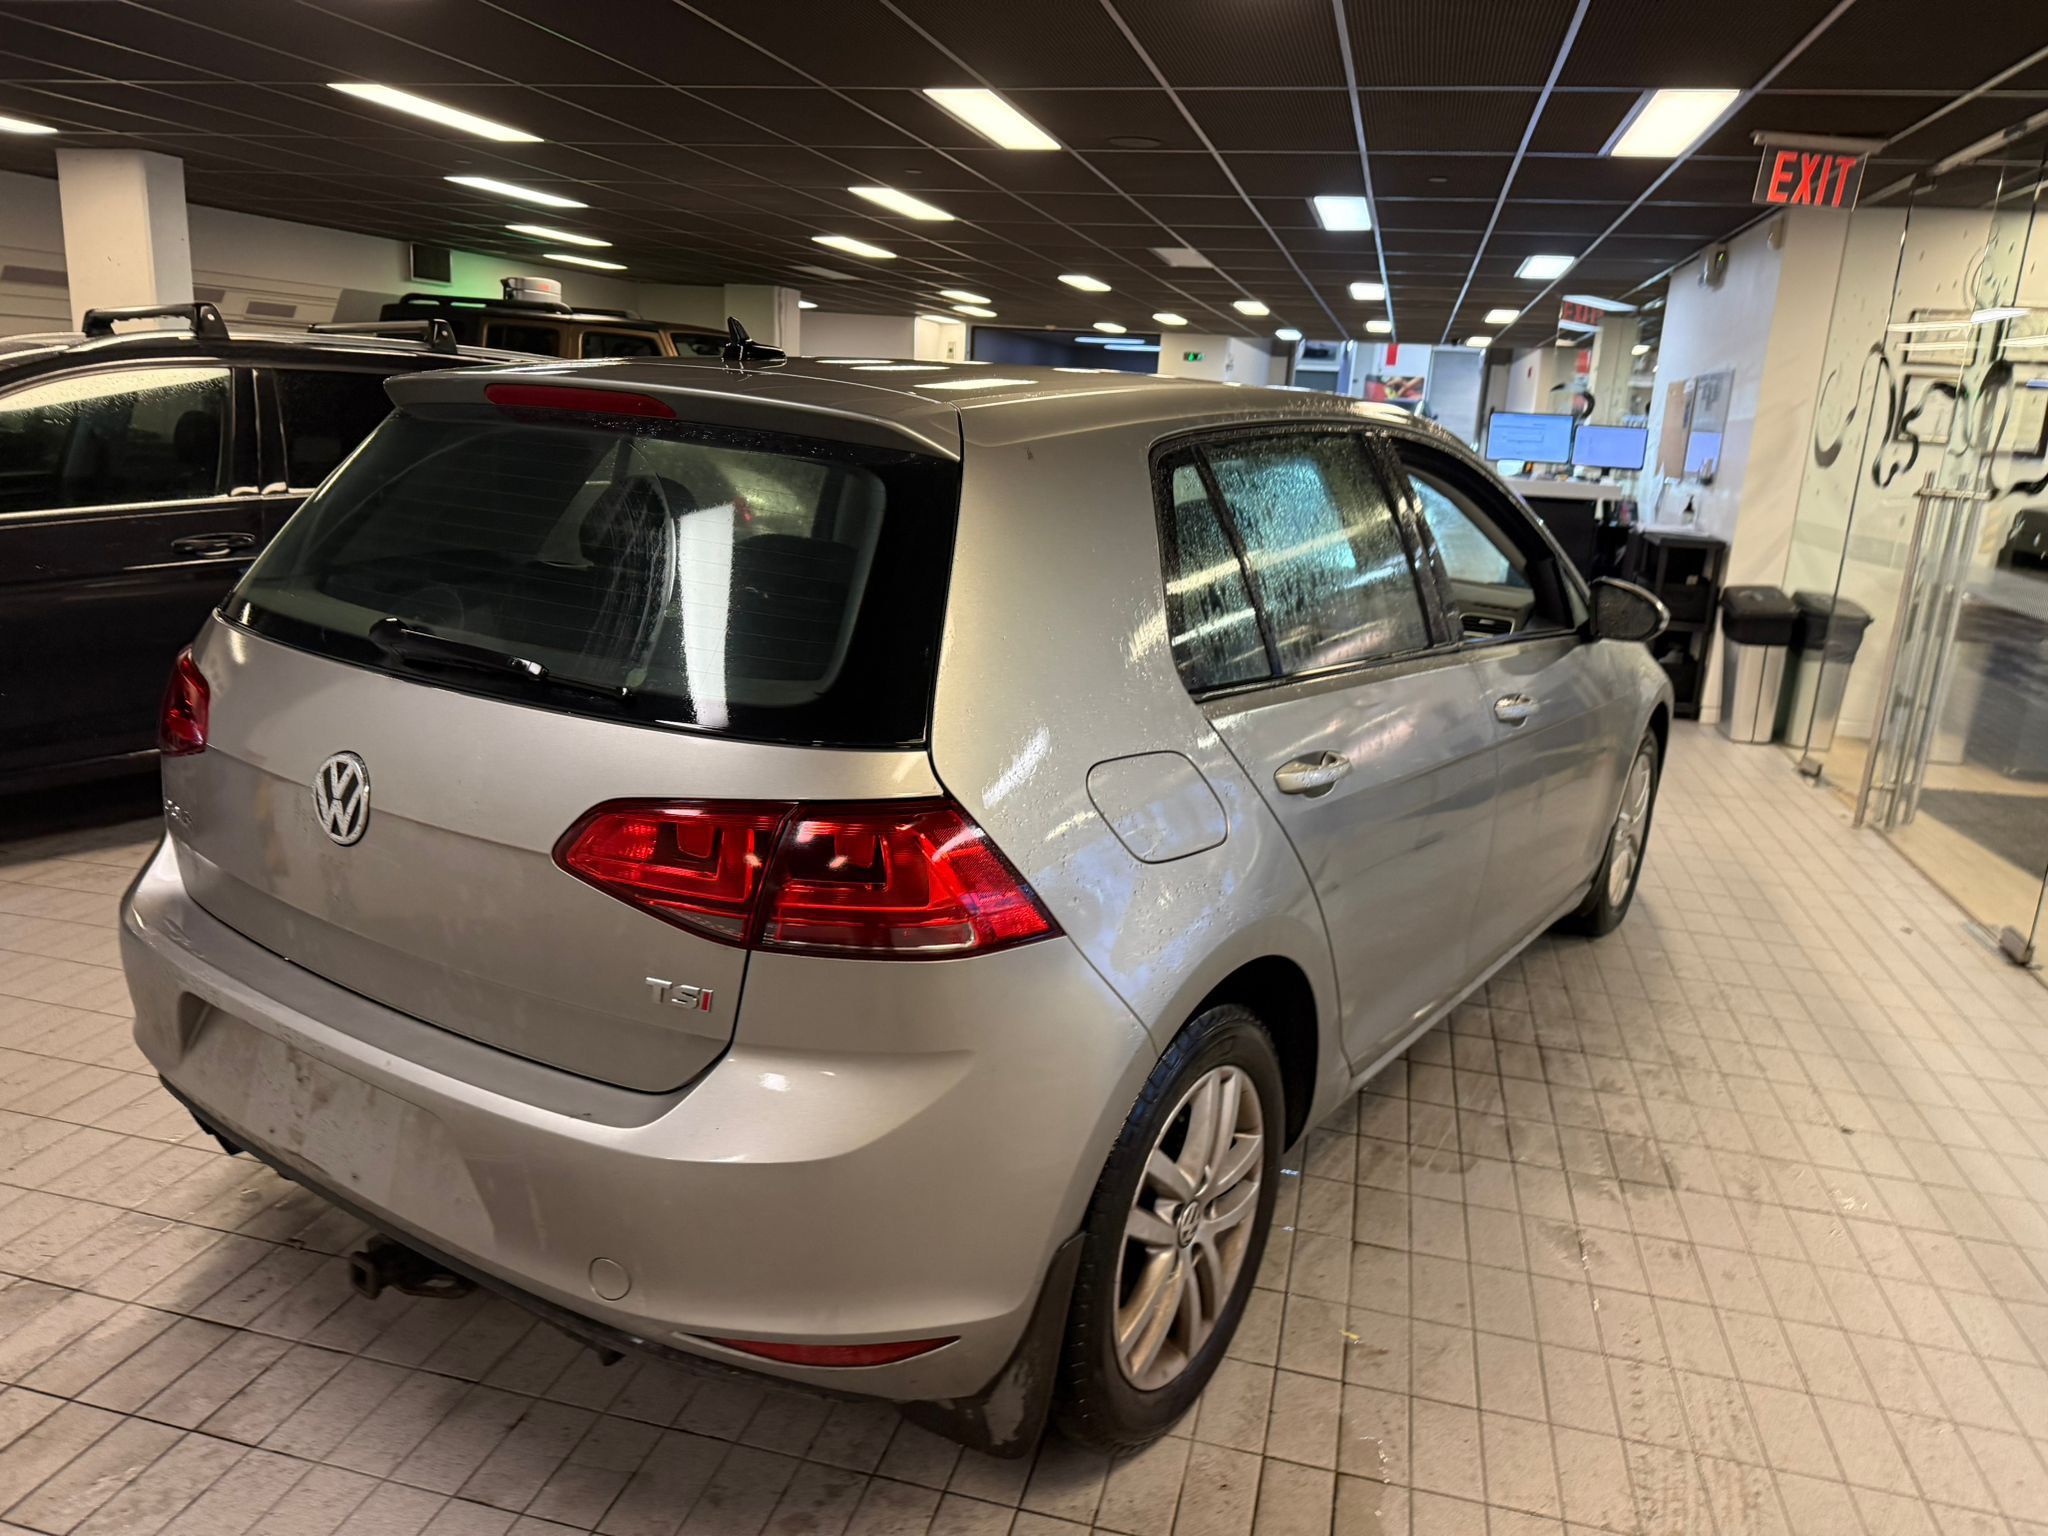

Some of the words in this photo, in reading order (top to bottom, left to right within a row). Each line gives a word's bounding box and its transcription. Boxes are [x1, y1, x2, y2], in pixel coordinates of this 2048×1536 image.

[1766, 150, 1857, 208] EXIT
[314, 754, 367, 843] VW
[645, 976, 714, 1013] TSI
